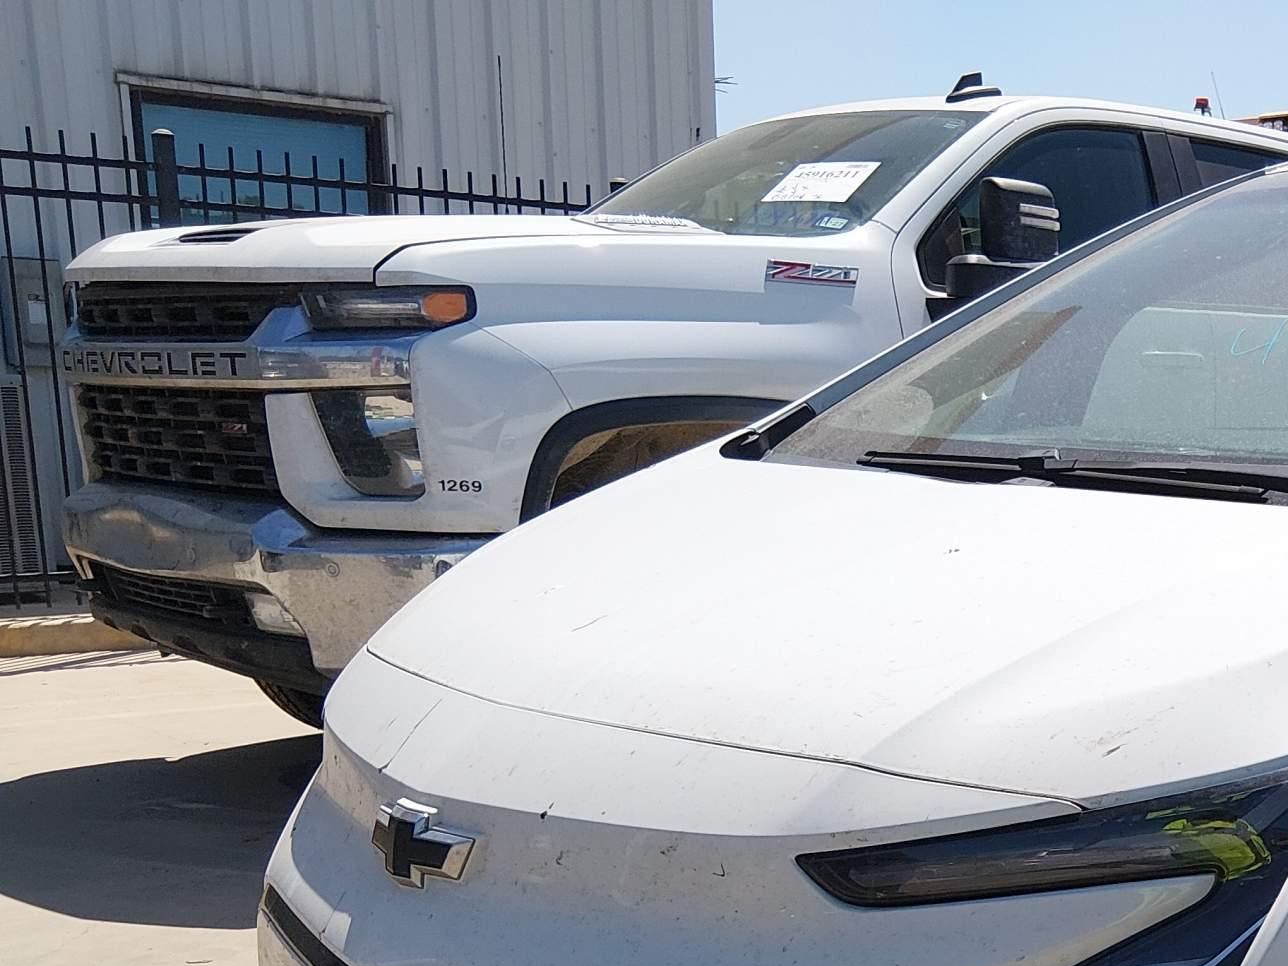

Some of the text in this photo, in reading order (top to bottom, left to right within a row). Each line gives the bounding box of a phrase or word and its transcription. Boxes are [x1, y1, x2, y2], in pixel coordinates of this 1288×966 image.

[766, 258, 859, 286] Z71
[62, 350, 247, 376] CHEVROLET
[437, 479, 482, 493] 1269
